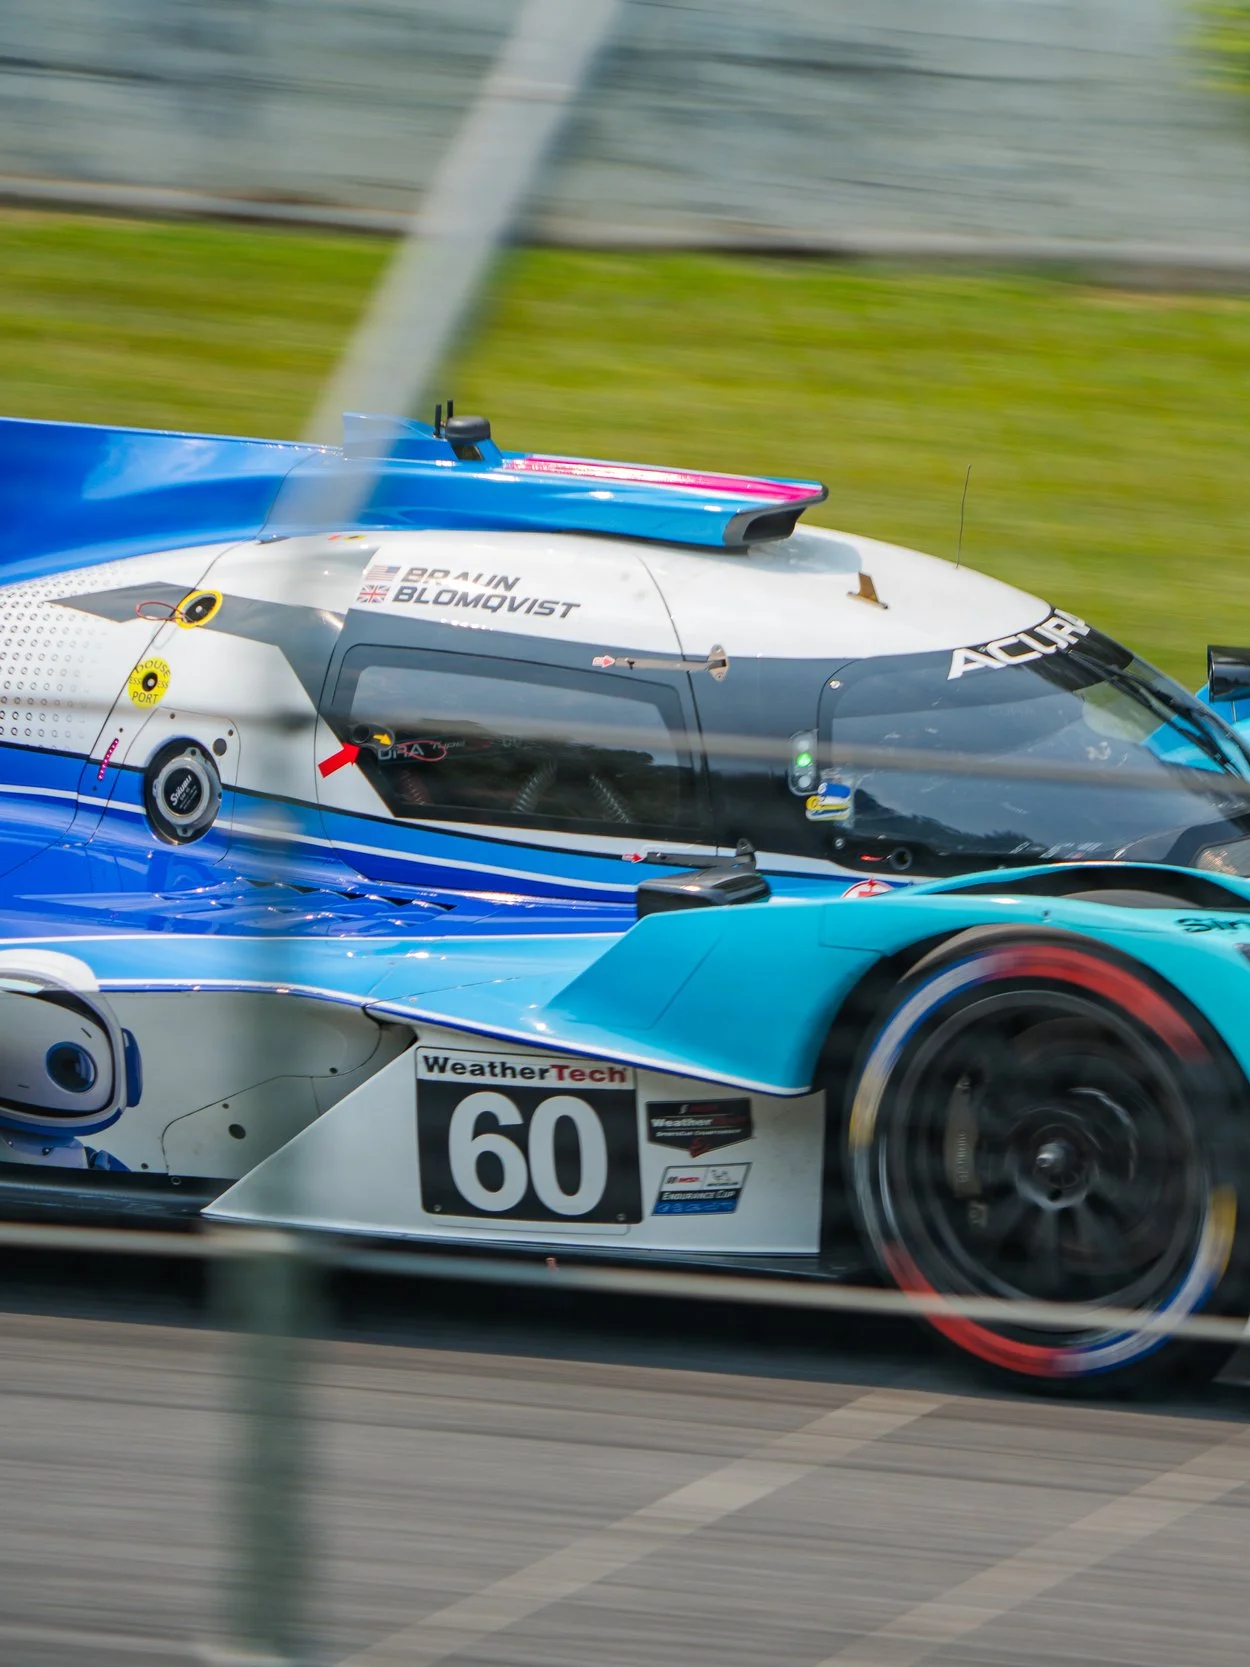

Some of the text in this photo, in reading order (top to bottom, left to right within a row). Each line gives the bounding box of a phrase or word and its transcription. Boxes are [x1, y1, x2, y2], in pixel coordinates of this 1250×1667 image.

[392, 585, 581, 619] BLOMQVIST
[131, 691, 159, 704] PORT
[422, 1055, 627, 1083] WeatherTech
[448, 1091, 609, 1217] 60
